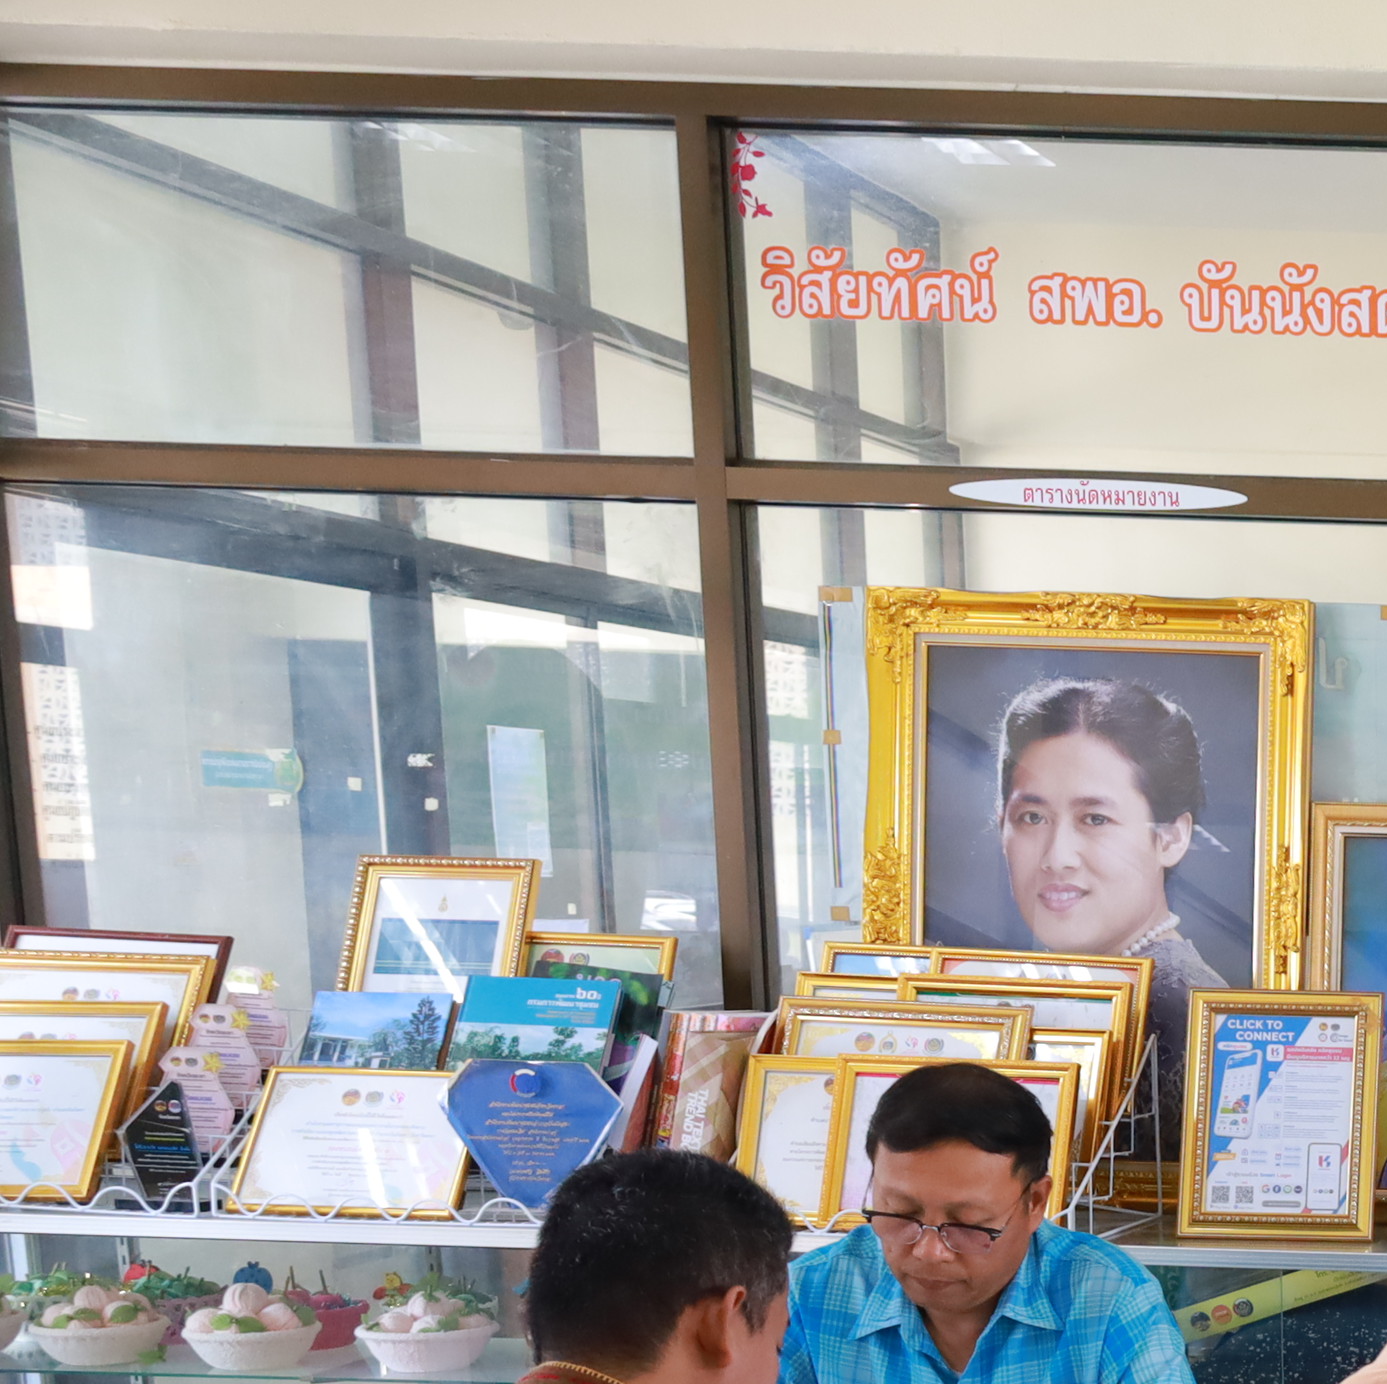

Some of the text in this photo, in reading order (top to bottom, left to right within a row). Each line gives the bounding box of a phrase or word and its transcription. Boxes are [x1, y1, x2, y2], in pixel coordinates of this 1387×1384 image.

[760, 246, 999, 323] วิสัยทัศน์
[1029, 271, 1164, 328] สพอ.
[1023, 480, 1181, 507] ตารางนัดหมายงาน
[1227, 1018, 1283, 1030] CLICK TO
[1235, 1031, 1295, 1042] CONNECT
